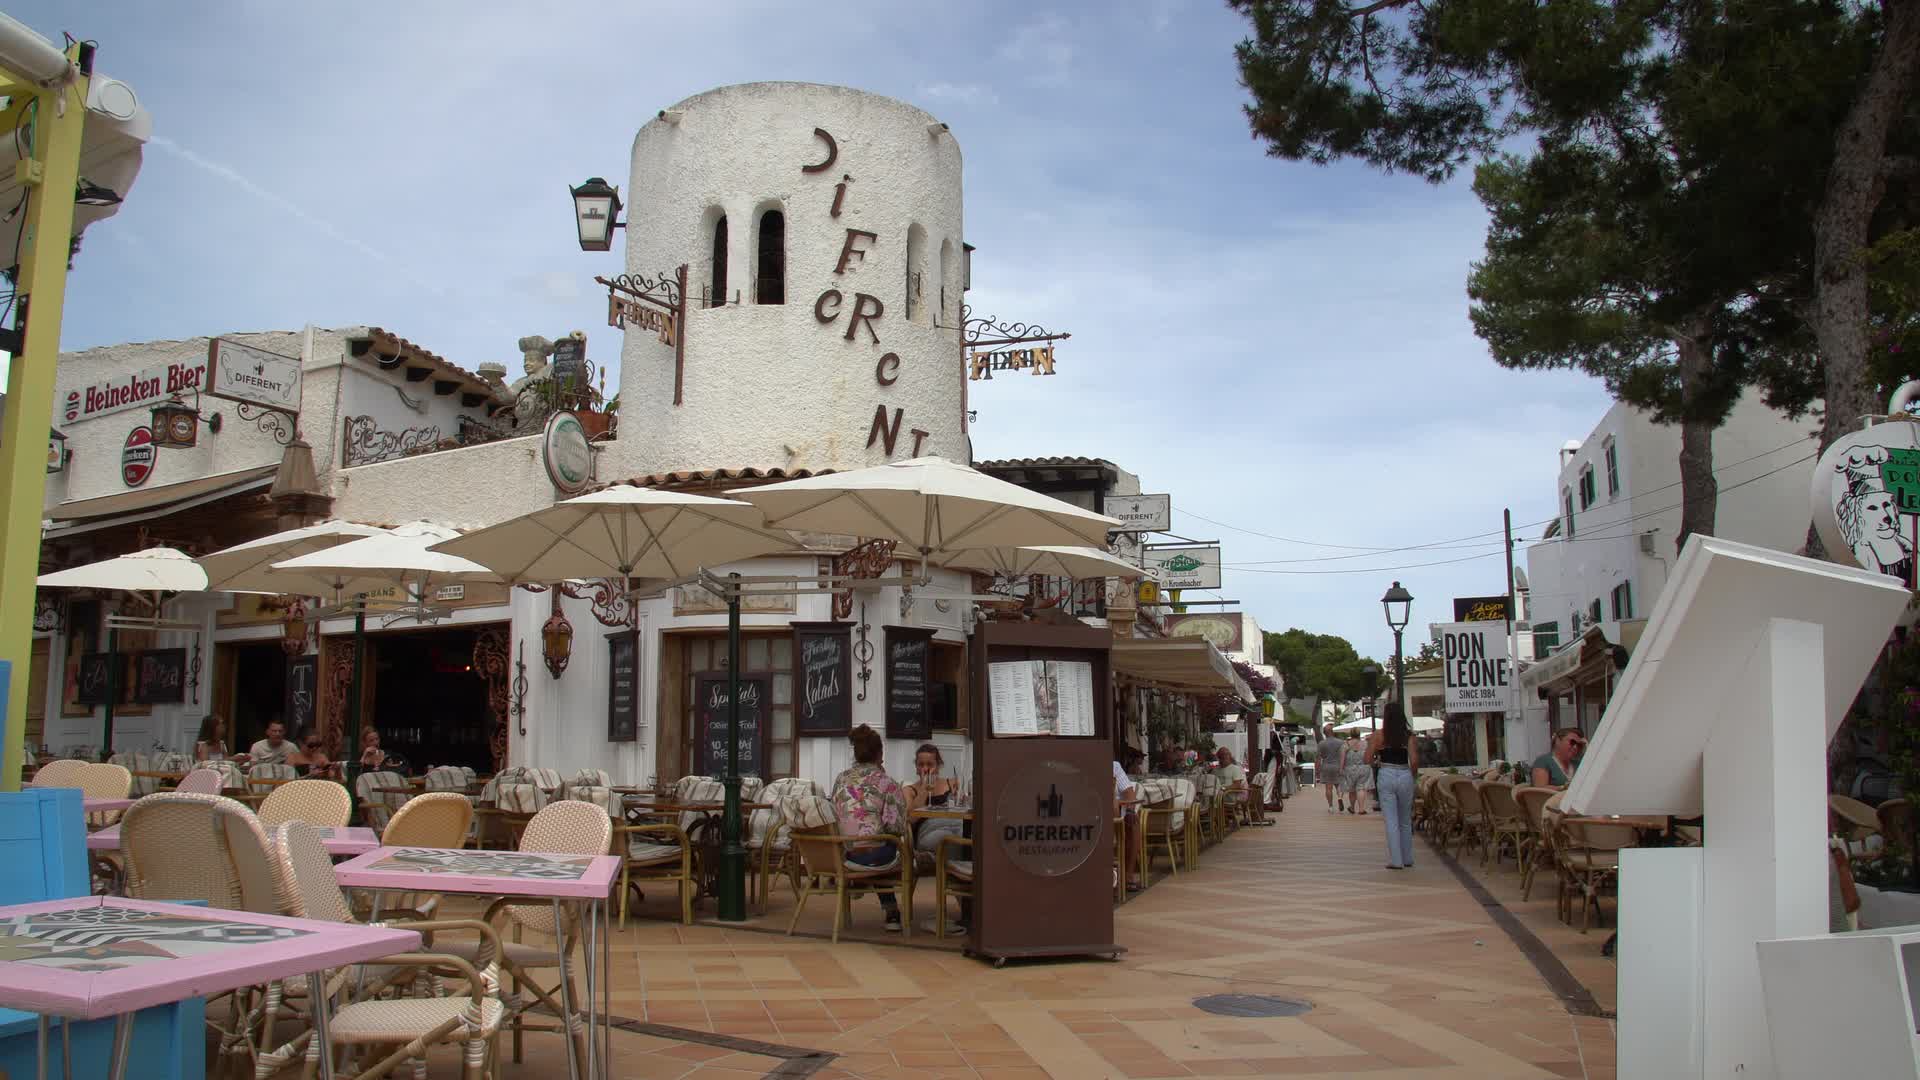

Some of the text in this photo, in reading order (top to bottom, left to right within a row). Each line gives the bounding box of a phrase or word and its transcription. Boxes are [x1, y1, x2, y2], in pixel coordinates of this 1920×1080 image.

[84, 363, 206, 414] Heineken Bier
[235, 372, 282, 392] DIFERENT
[1118, 513, 1154, 521] DIFERENT
[1444, 632, 1484, 660] DON
[1446, 659, 1508, 688] LEONE
[805, 668, 840, 719] Salads
[1459, 689, 1496, 699] SINCE 1984
[1004, 825, 1094, 841] DIFERENT
